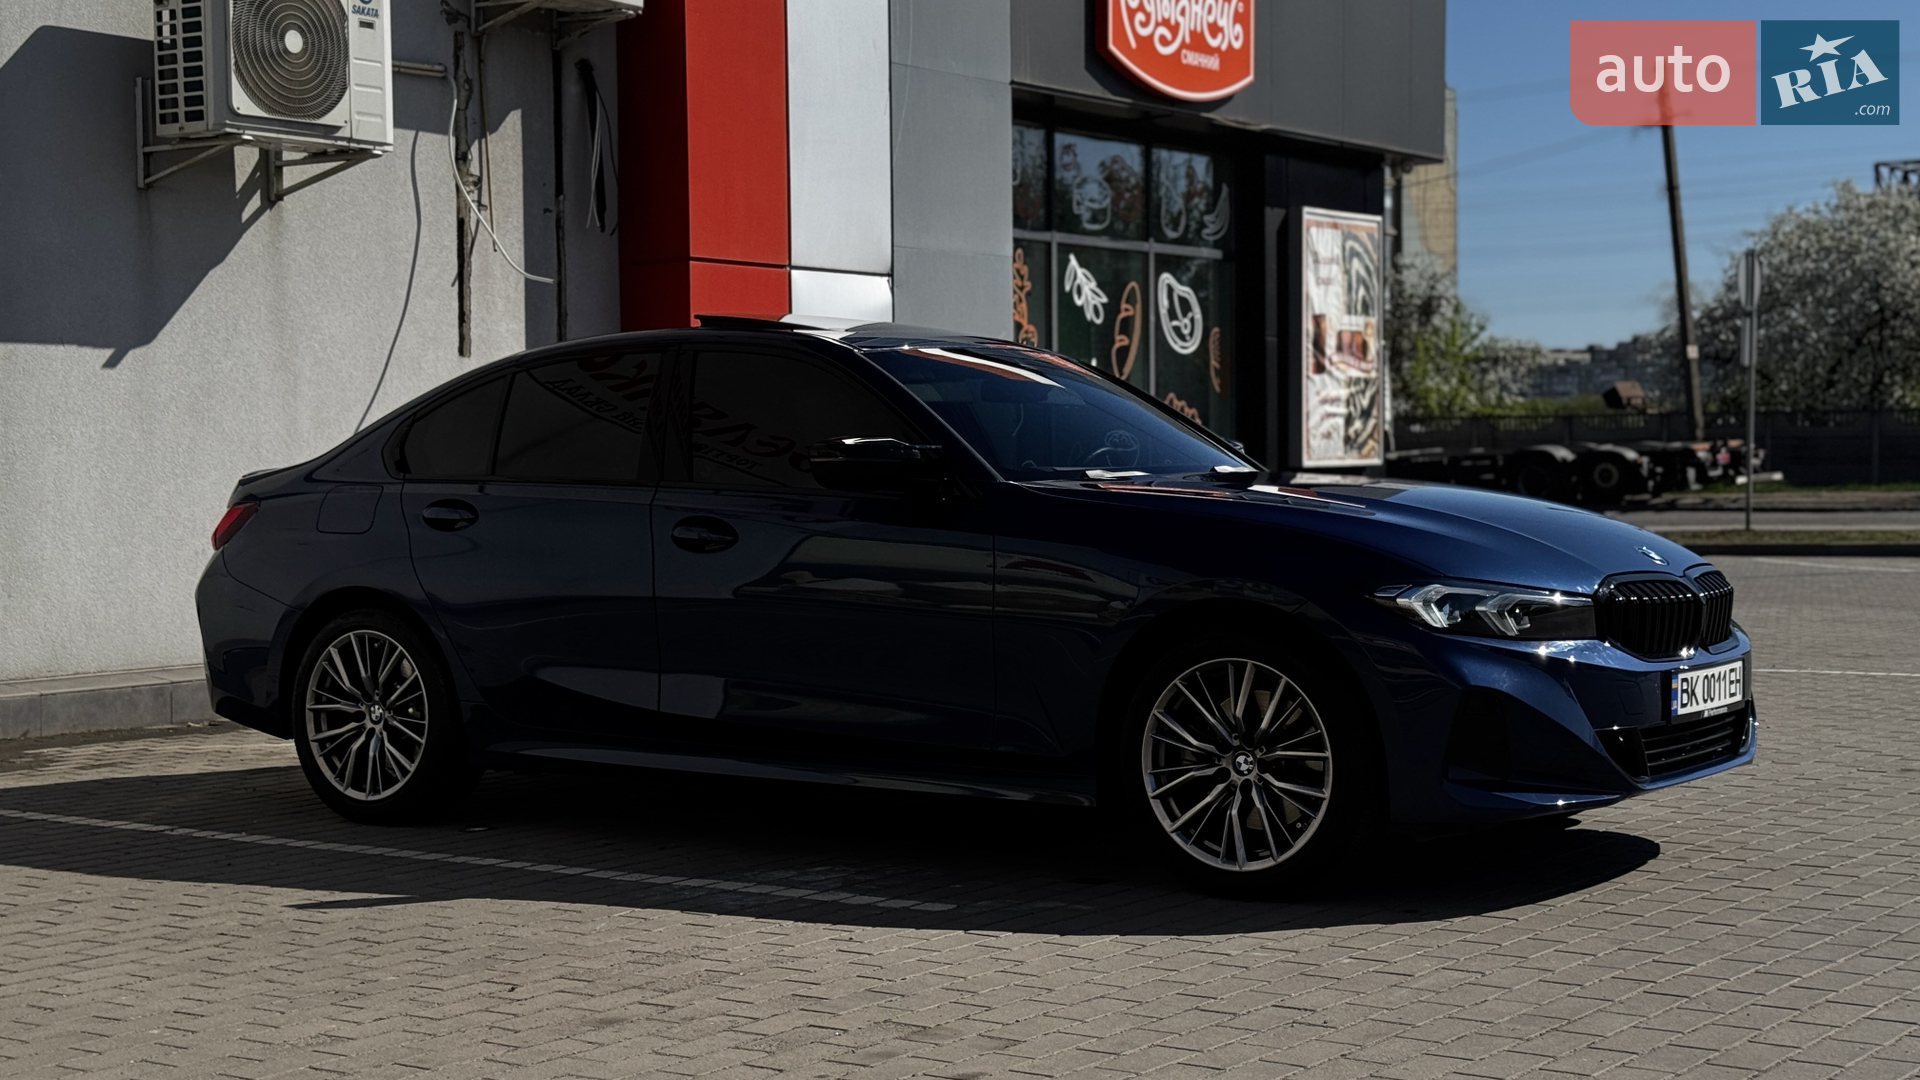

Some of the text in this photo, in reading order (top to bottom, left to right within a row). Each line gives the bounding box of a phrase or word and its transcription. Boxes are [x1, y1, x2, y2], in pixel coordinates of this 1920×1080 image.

[351, 4, 379, 18] SAKATA
[1180, 49, 1220, 71] СМАЧНИЙ
[1681, 667, 1741, 708] BK 0011 EH
